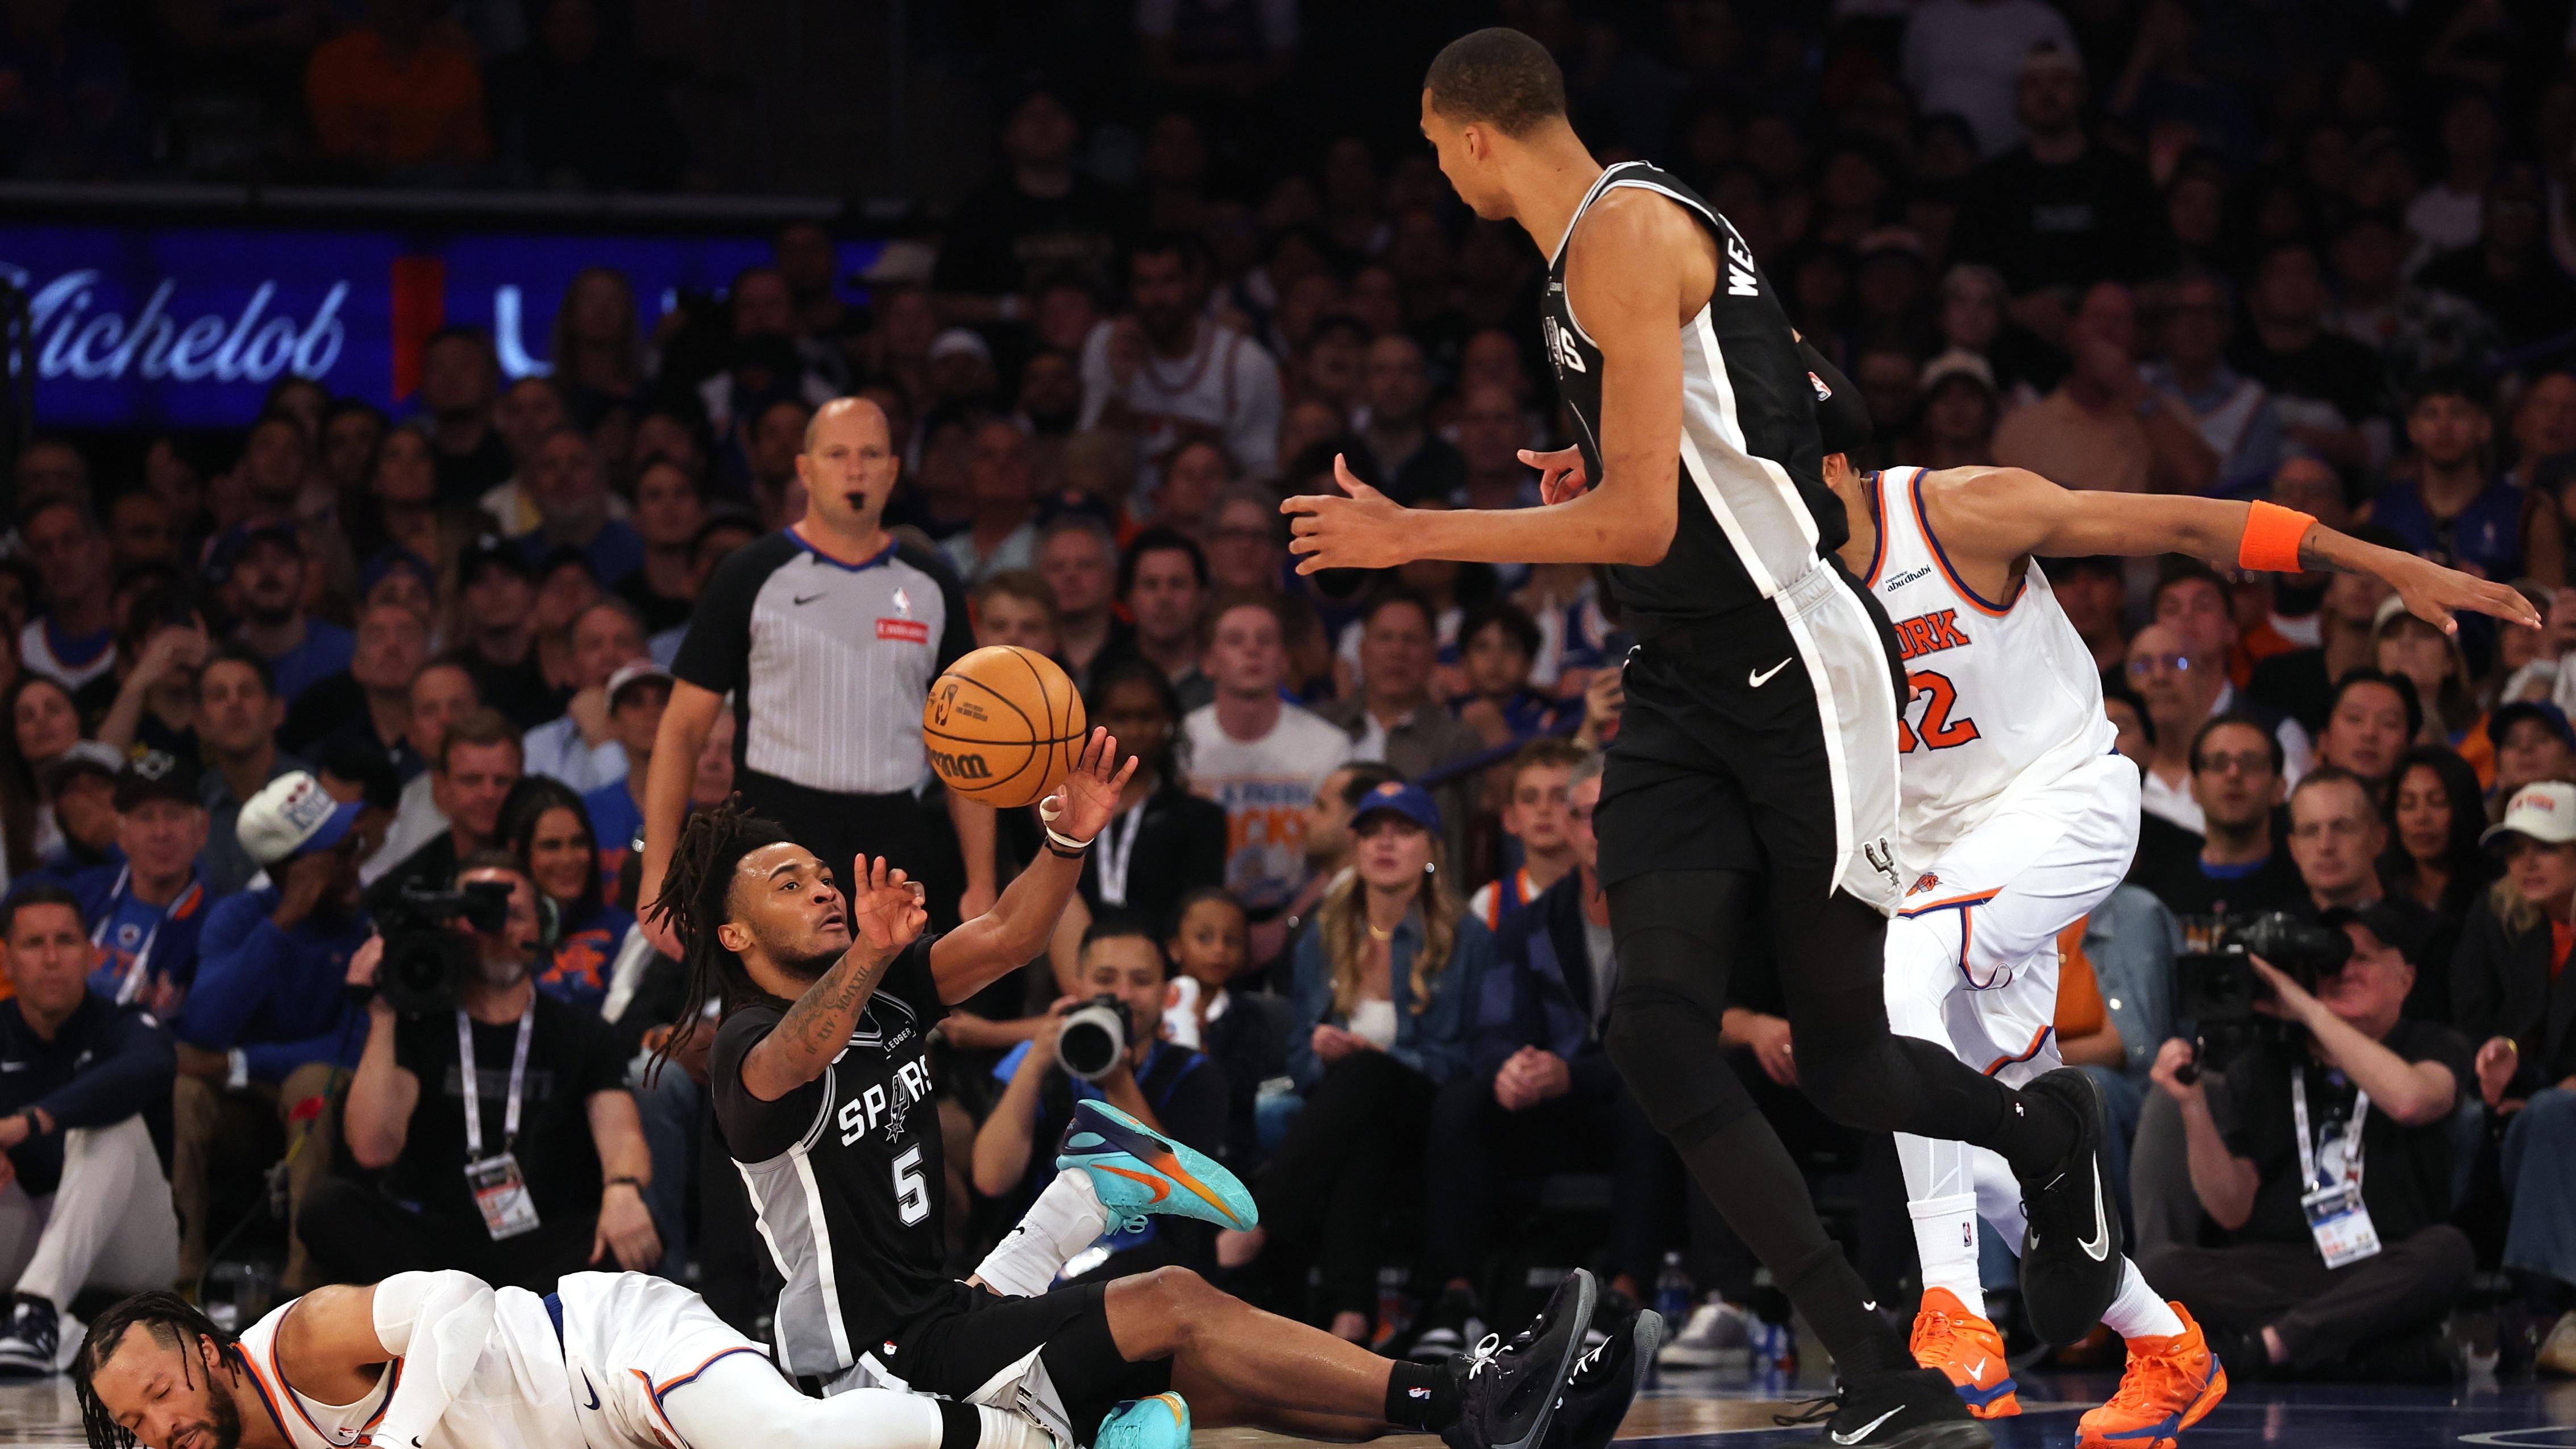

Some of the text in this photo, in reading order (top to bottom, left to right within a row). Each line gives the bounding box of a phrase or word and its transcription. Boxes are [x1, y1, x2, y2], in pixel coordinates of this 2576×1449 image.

[1718, 213, 1759, 296] WE
[1888, 564, 1931, 592] abu dhabi
[1894, 607, 1972, 661] ORK
[1898, 669, 1981, 754] 2
[884, 1027, 912, 1052] LEDGER
[891, 1142, 931, 1227] 5
